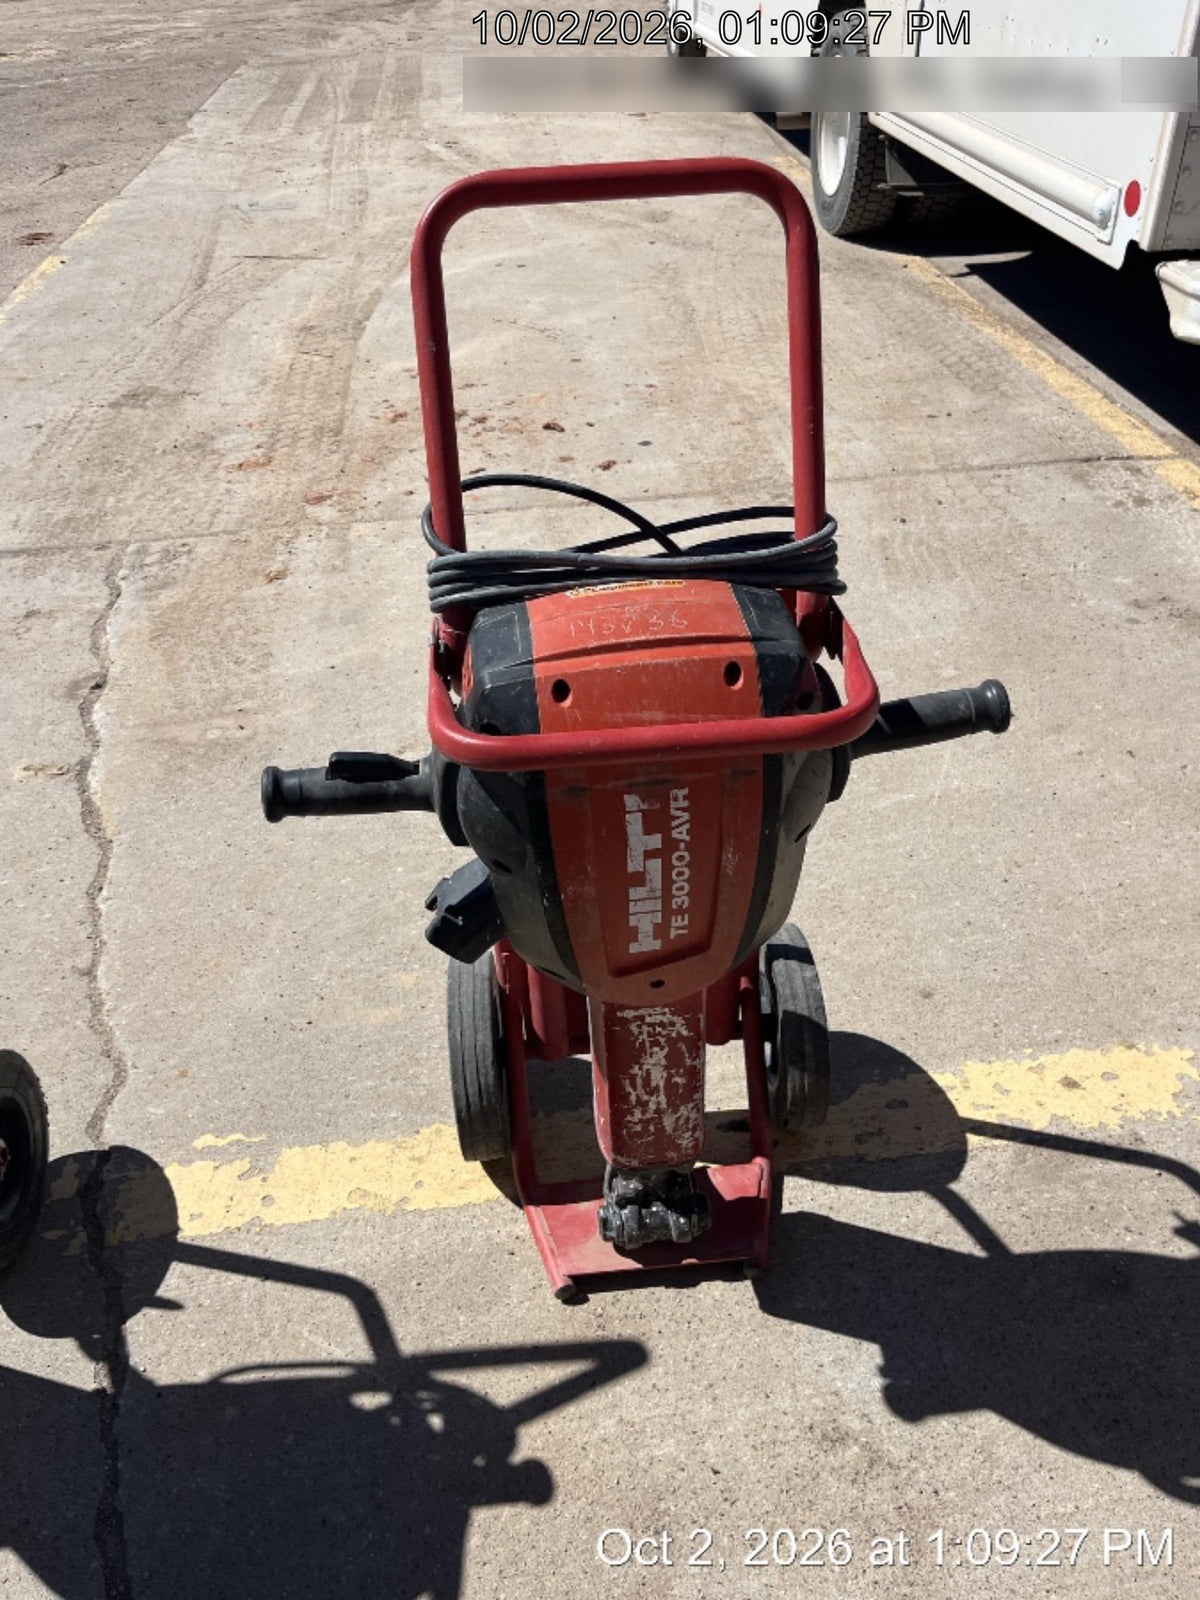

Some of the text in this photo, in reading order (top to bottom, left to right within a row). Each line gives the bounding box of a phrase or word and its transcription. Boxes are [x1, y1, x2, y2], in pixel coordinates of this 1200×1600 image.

[624, 794, 662, 954] HILTI
[670, 788, 691, 939] TE 3000-AVR
